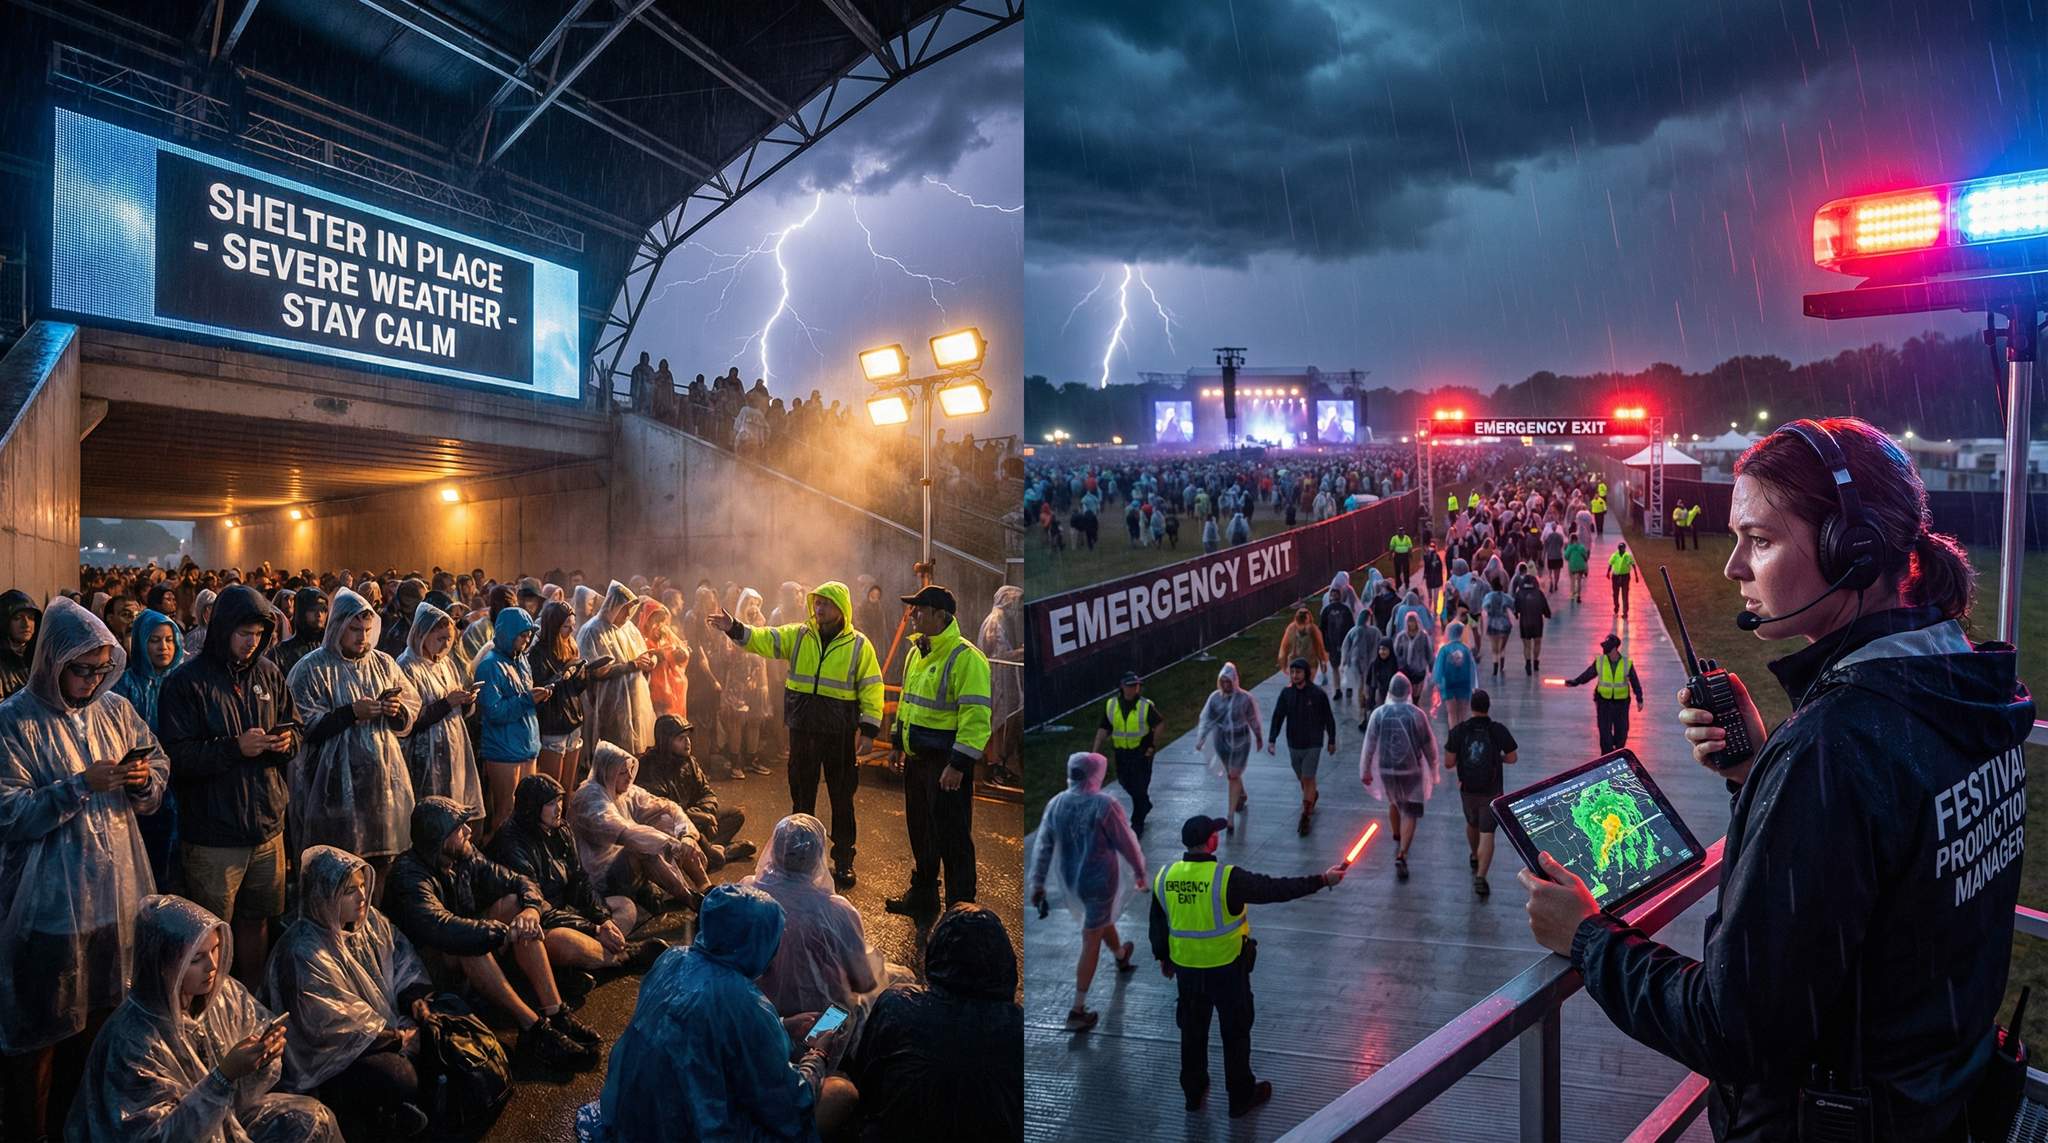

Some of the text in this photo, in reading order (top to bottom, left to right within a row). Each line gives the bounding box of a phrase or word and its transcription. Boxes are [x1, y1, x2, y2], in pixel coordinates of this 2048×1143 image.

[208, 182, 503, 294] SHELTER IN PLACE
[222, 232, 360, 297] SEVERE
[368, 268, 501, 330] WEATHER
[281, 292, 456, 358] STAY CALM
[1474, 421, 1607, 434] EMERGENCY EXIT
[1049, 540, 1292, 657] EMERGENCY EXIT
[1934, 744, 2026, 841] FESTIVAL
[1954, 824, 2025, 908] MANAGER
